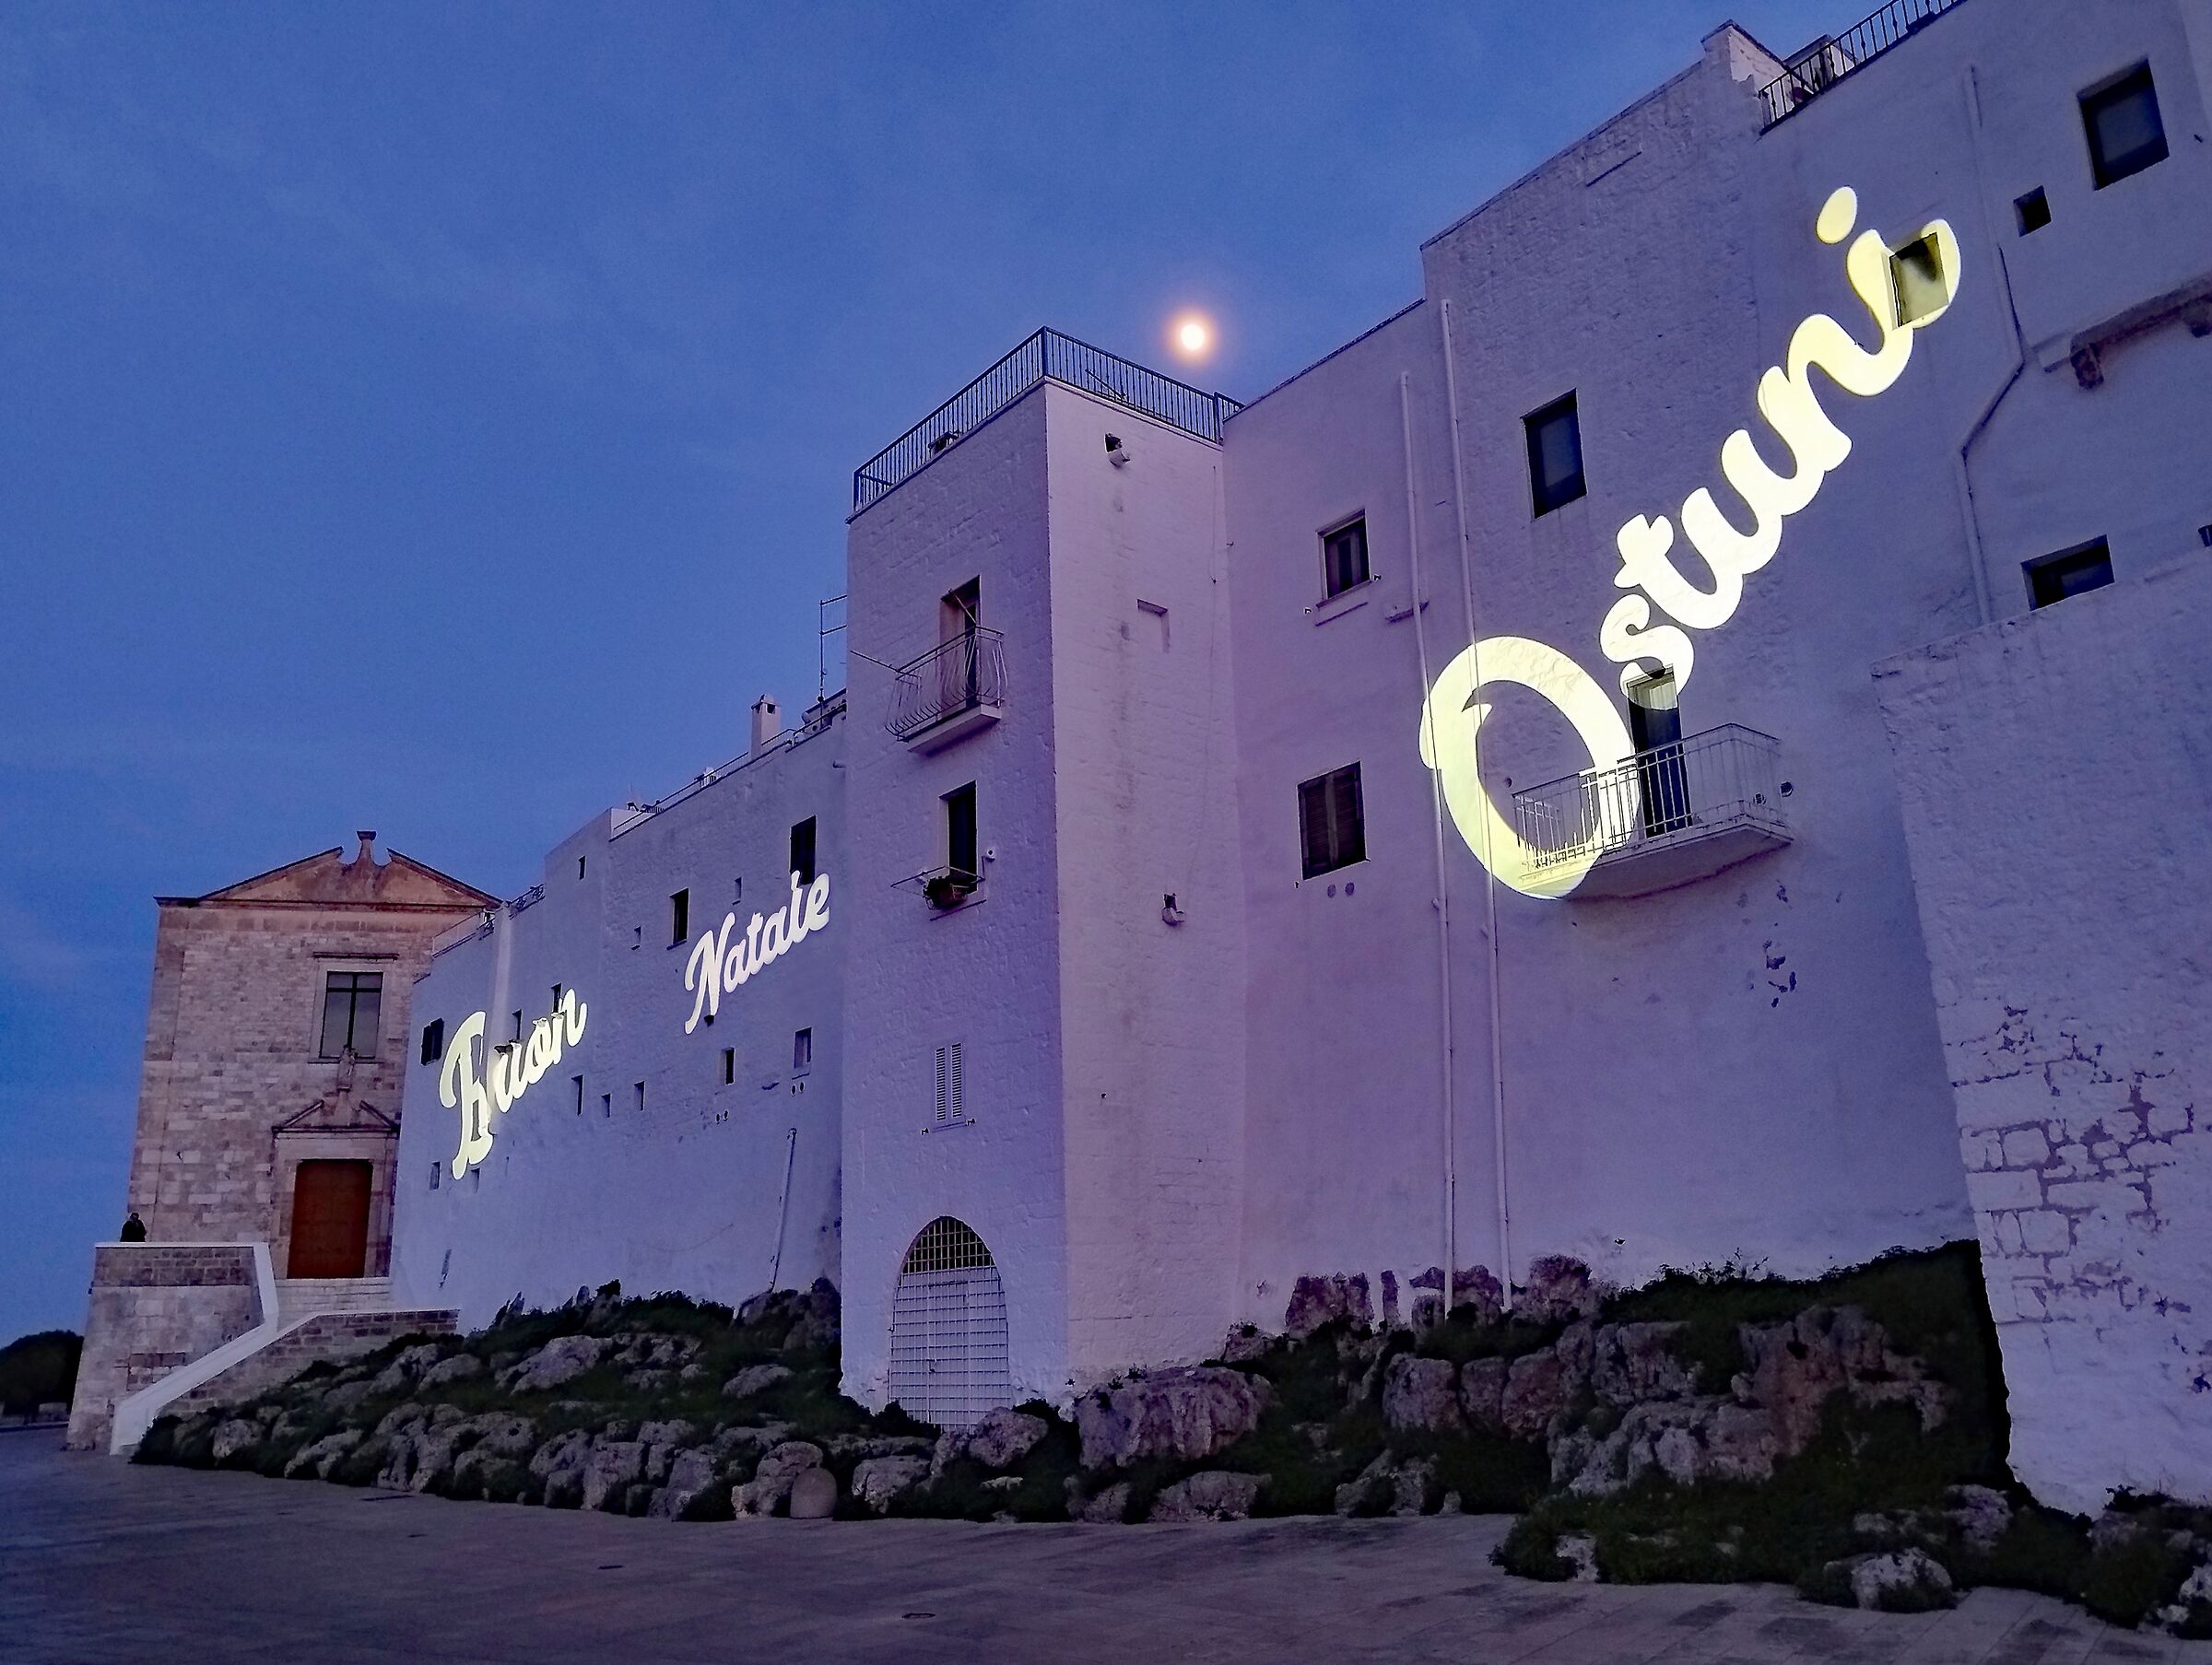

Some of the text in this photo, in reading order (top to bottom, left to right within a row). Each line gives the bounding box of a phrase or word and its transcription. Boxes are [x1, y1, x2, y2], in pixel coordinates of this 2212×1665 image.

[439, 186, 1962, 1180] Buon Natale Ostuni
